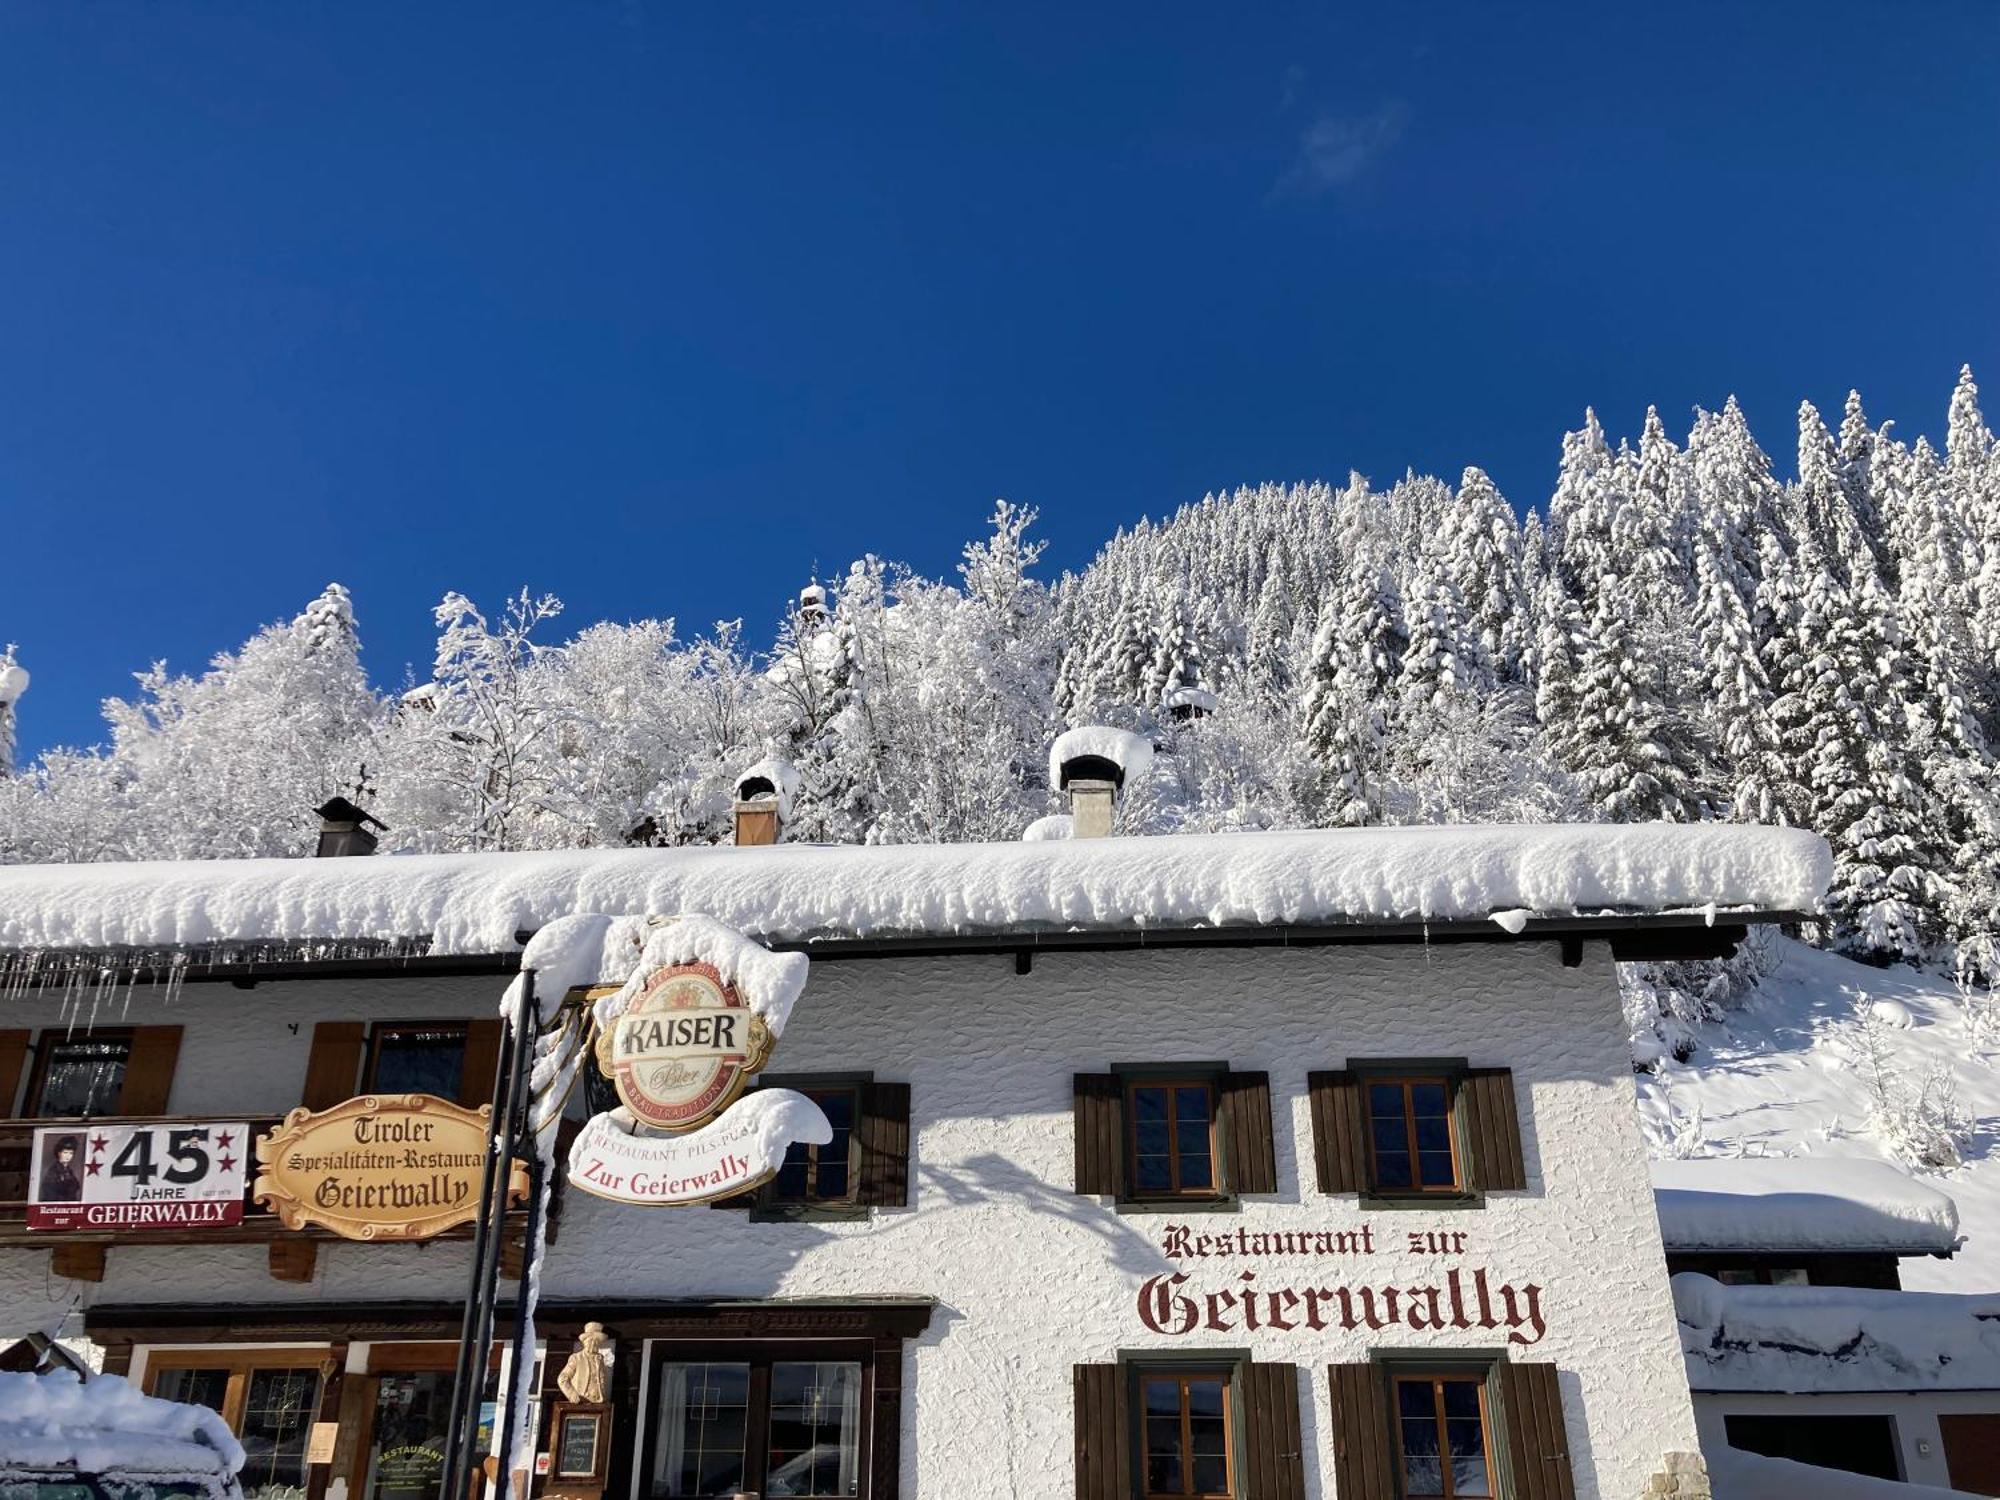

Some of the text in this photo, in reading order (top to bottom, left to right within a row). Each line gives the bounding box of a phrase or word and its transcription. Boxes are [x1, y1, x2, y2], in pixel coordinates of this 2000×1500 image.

[625, 1015, 736, 1054] KAISER
[354, 1117, 434, 1144] Tiroler
[110, 1129, 209, 1185] 45
[594, 1136, 677, 1161] RESTAURANT
[583, 1152, 749, 1195] Zur Geierwally
[130, 1187, 185, 1200] JAHRE
[315, 1174, 469, 1209] Geierwally
[87, 1202, 229, 1224] GEIERWALLY
[1162, 1224, 1468, 1258] Restaurant zur
[1137, 1266, 1546, 1345] Geierwally
[377, 1446, 444, 1464] RESTAURANT
